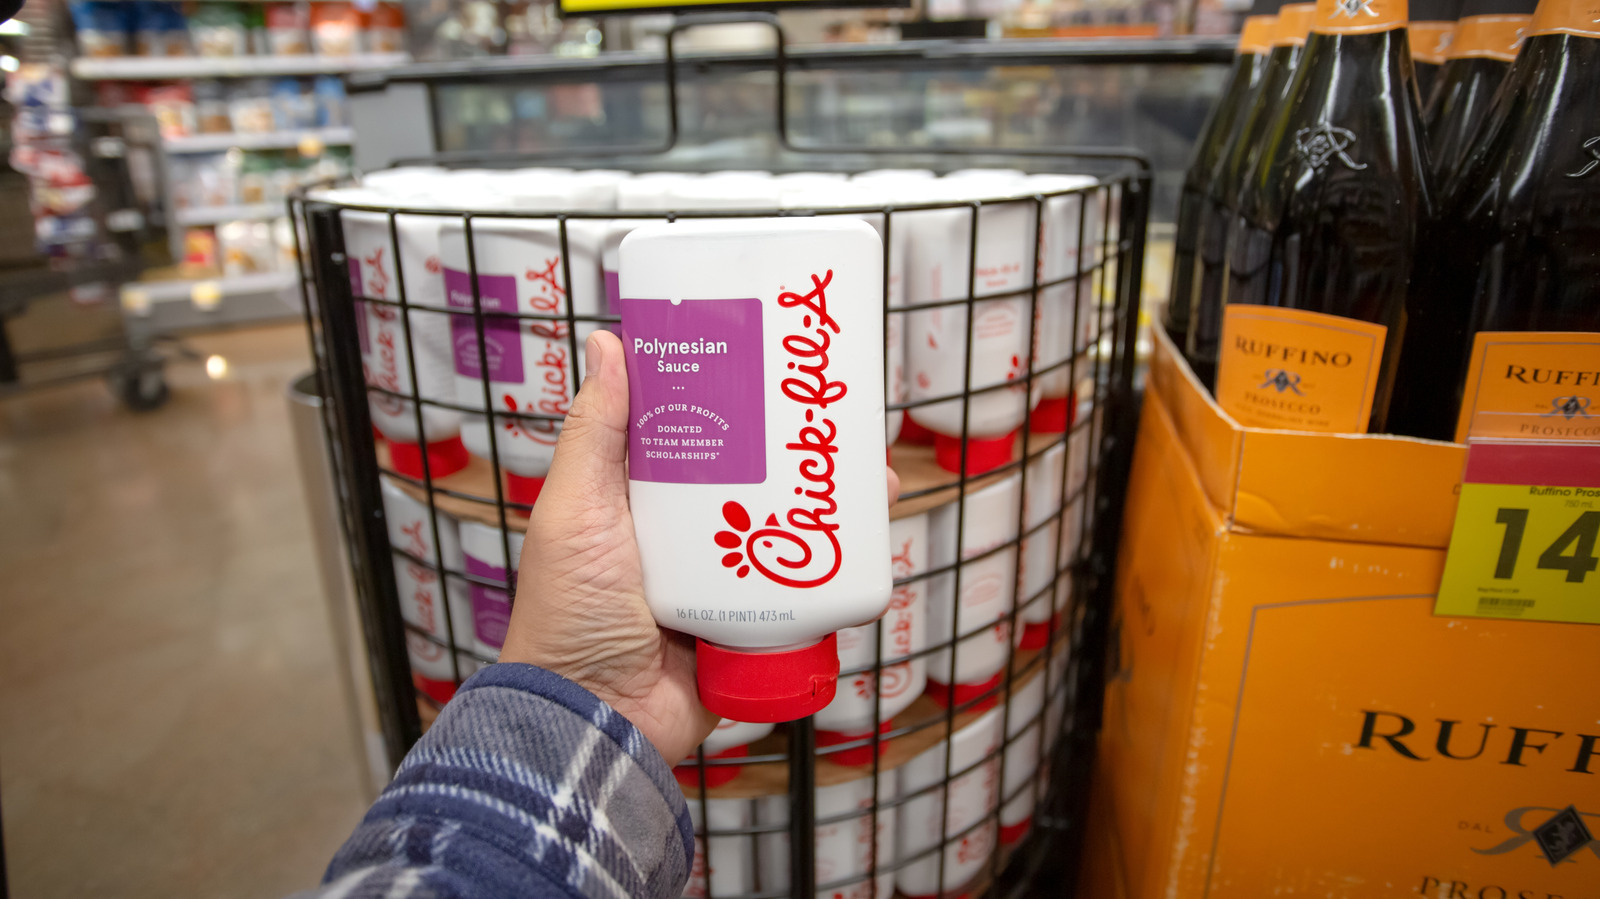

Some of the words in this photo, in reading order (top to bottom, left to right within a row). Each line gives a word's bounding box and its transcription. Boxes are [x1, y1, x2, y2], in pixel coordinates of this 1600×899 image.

[517, 256, 568, 446] Chick-fl-A
[633, 337, 728, 359] Polynesian
[1235, 334, 1353, 368] RUFFINO
[657, 360, 700, 373] Sauce
[1504, 364, 1600, 386] RUFFI
[1244, 391, 1322, 415] PROSECCO
[636, 410, 654, 429] 100%
[654, 405, 666, 415] OF
[667, 403, 688, 412] OUR
[690, 405, 730, 431] PROFITS
[657, 425, 703, 434] DONATED
[745, 268, 848, 589] Chick-fil-A
[640, 437, 652, 445] TO
[653, 438, 679, 446] TEAM
[681, 439, 724, 447] MEMBER
[1529, 486, 1571, 497] Ruffino
[1564, 500, 1580, 509] 750
[1493, 507, 1600, 584] 14
[676, 608, 687, 619] 16
[688, 609, 699, 620] FL
[700, 609, 717, 621] OZ.
[718, 609, 726, 622] (1
[728, 610, 757, 622] PINT)
[759, 610, 777, 622] 473
[779, 609, 796, 621] mL
[1352, 709, 1600, 775] RUFF
[1457, 820, 1494, 834] DAL
[1418, 876, 1564, 899] PRO
